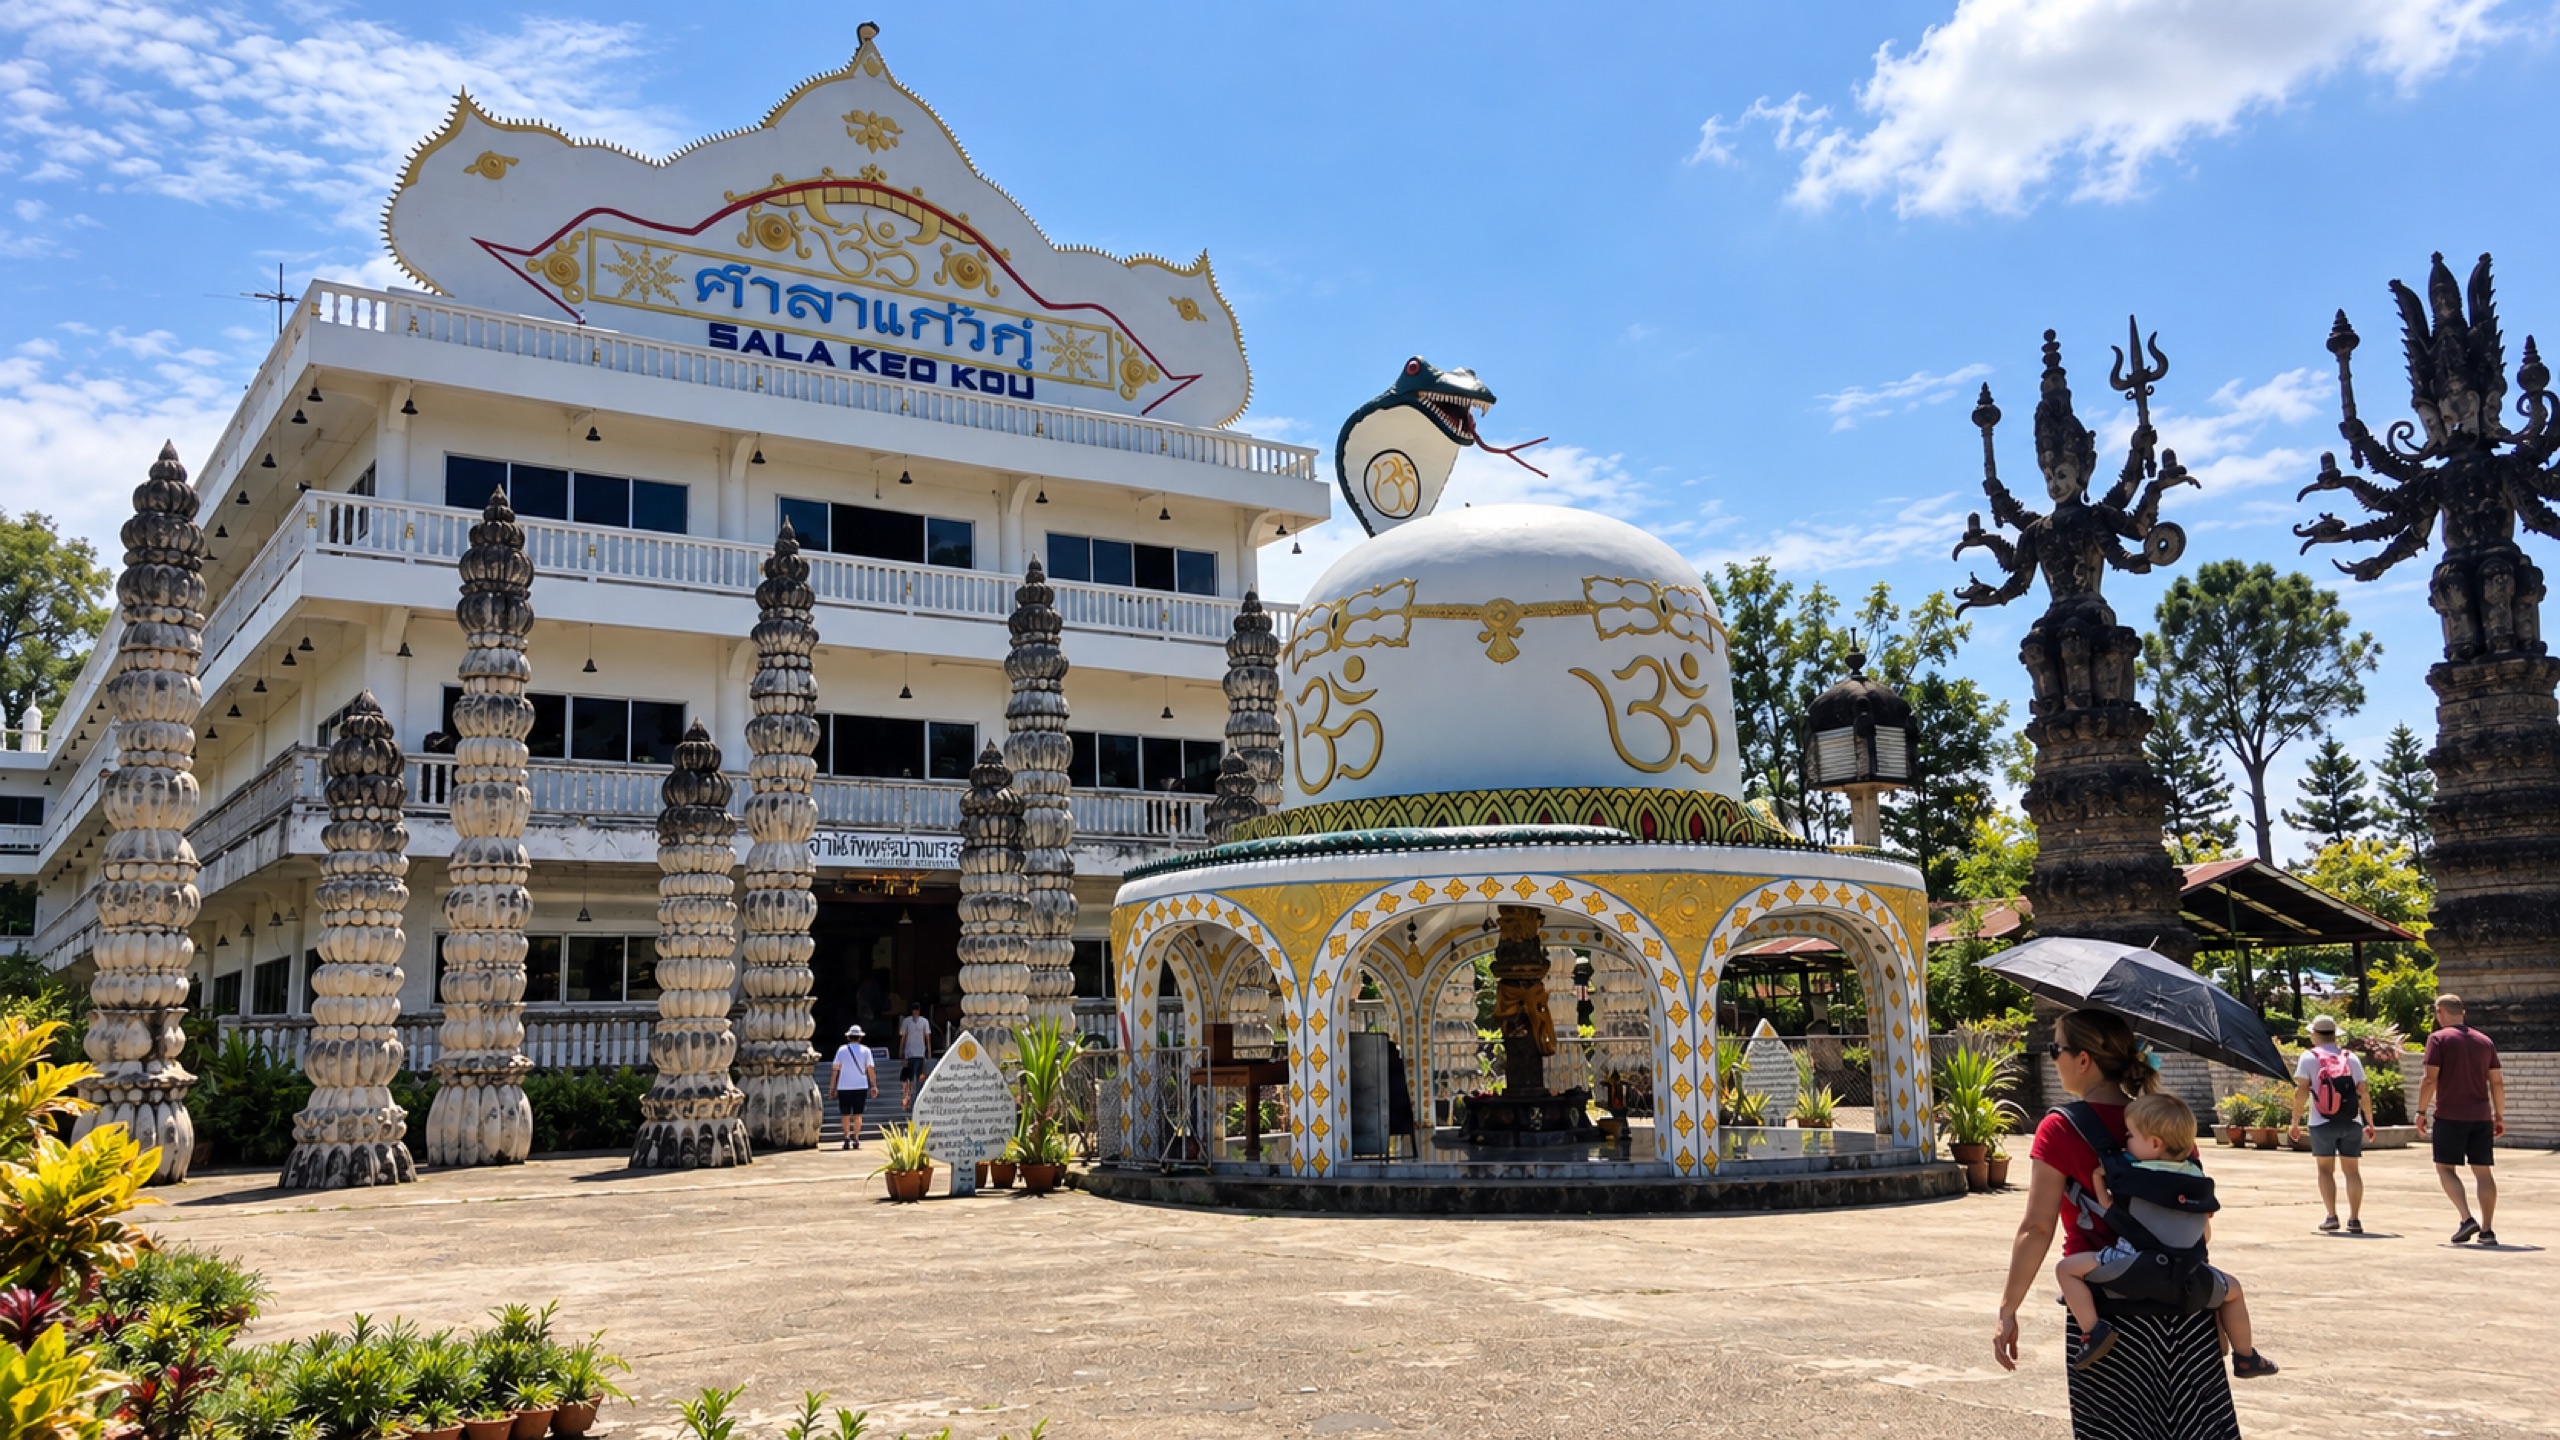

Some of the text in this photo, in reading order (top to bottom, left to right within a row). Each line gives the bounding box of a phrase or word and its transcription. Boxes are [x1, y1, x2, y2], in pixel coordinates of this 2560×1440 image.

[709, 322, 1035, 400] SALA KEO KOU
